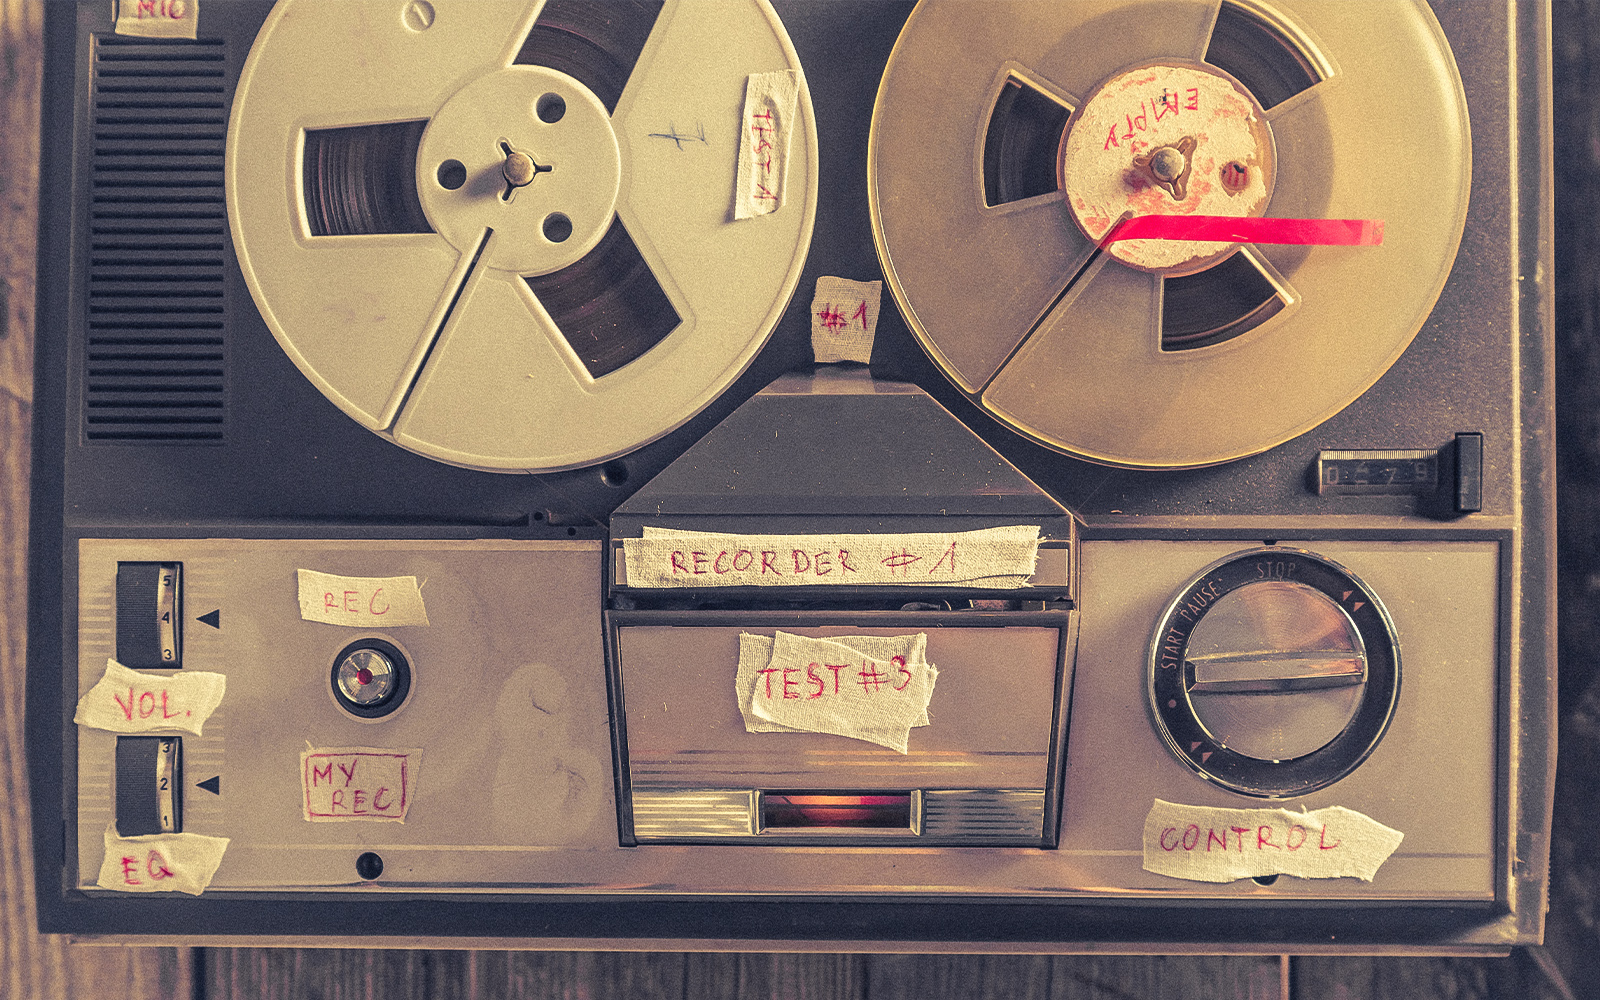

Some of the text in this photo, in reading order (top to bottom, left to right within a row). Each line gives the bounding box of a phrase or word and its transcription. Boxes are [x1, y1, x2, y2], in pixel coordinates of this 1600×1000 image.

[1104, 88, 1198, 150] EMPTY
[752, 109, 774, 174] TEST
[670, 549, 856, 577] RECORDER
[1256, 561, 1296, 579] STOP
[162, 575, 172, 587] 5
[324, 588, 390, 615] REC
[1180, 580, 1221, 622] PAUSE
[161, 611, 170, 624] 4
[163, 649, 172, 660] 3
[1161, 627, 1185, 670] START
[757, 662, 850, 700] TEST
[114, 687, 192, 720] VOL.
[162, 742, 170, 753] 3
[159, 777, 168, 790] 2
[313, 759, 358, 787] MY
[332, 787, 395, 813] REC
[163, 815, 169, 827] 1
[1160, 825, 1341, 852] CONTROL
[121, 849, 174, 885] EQ
